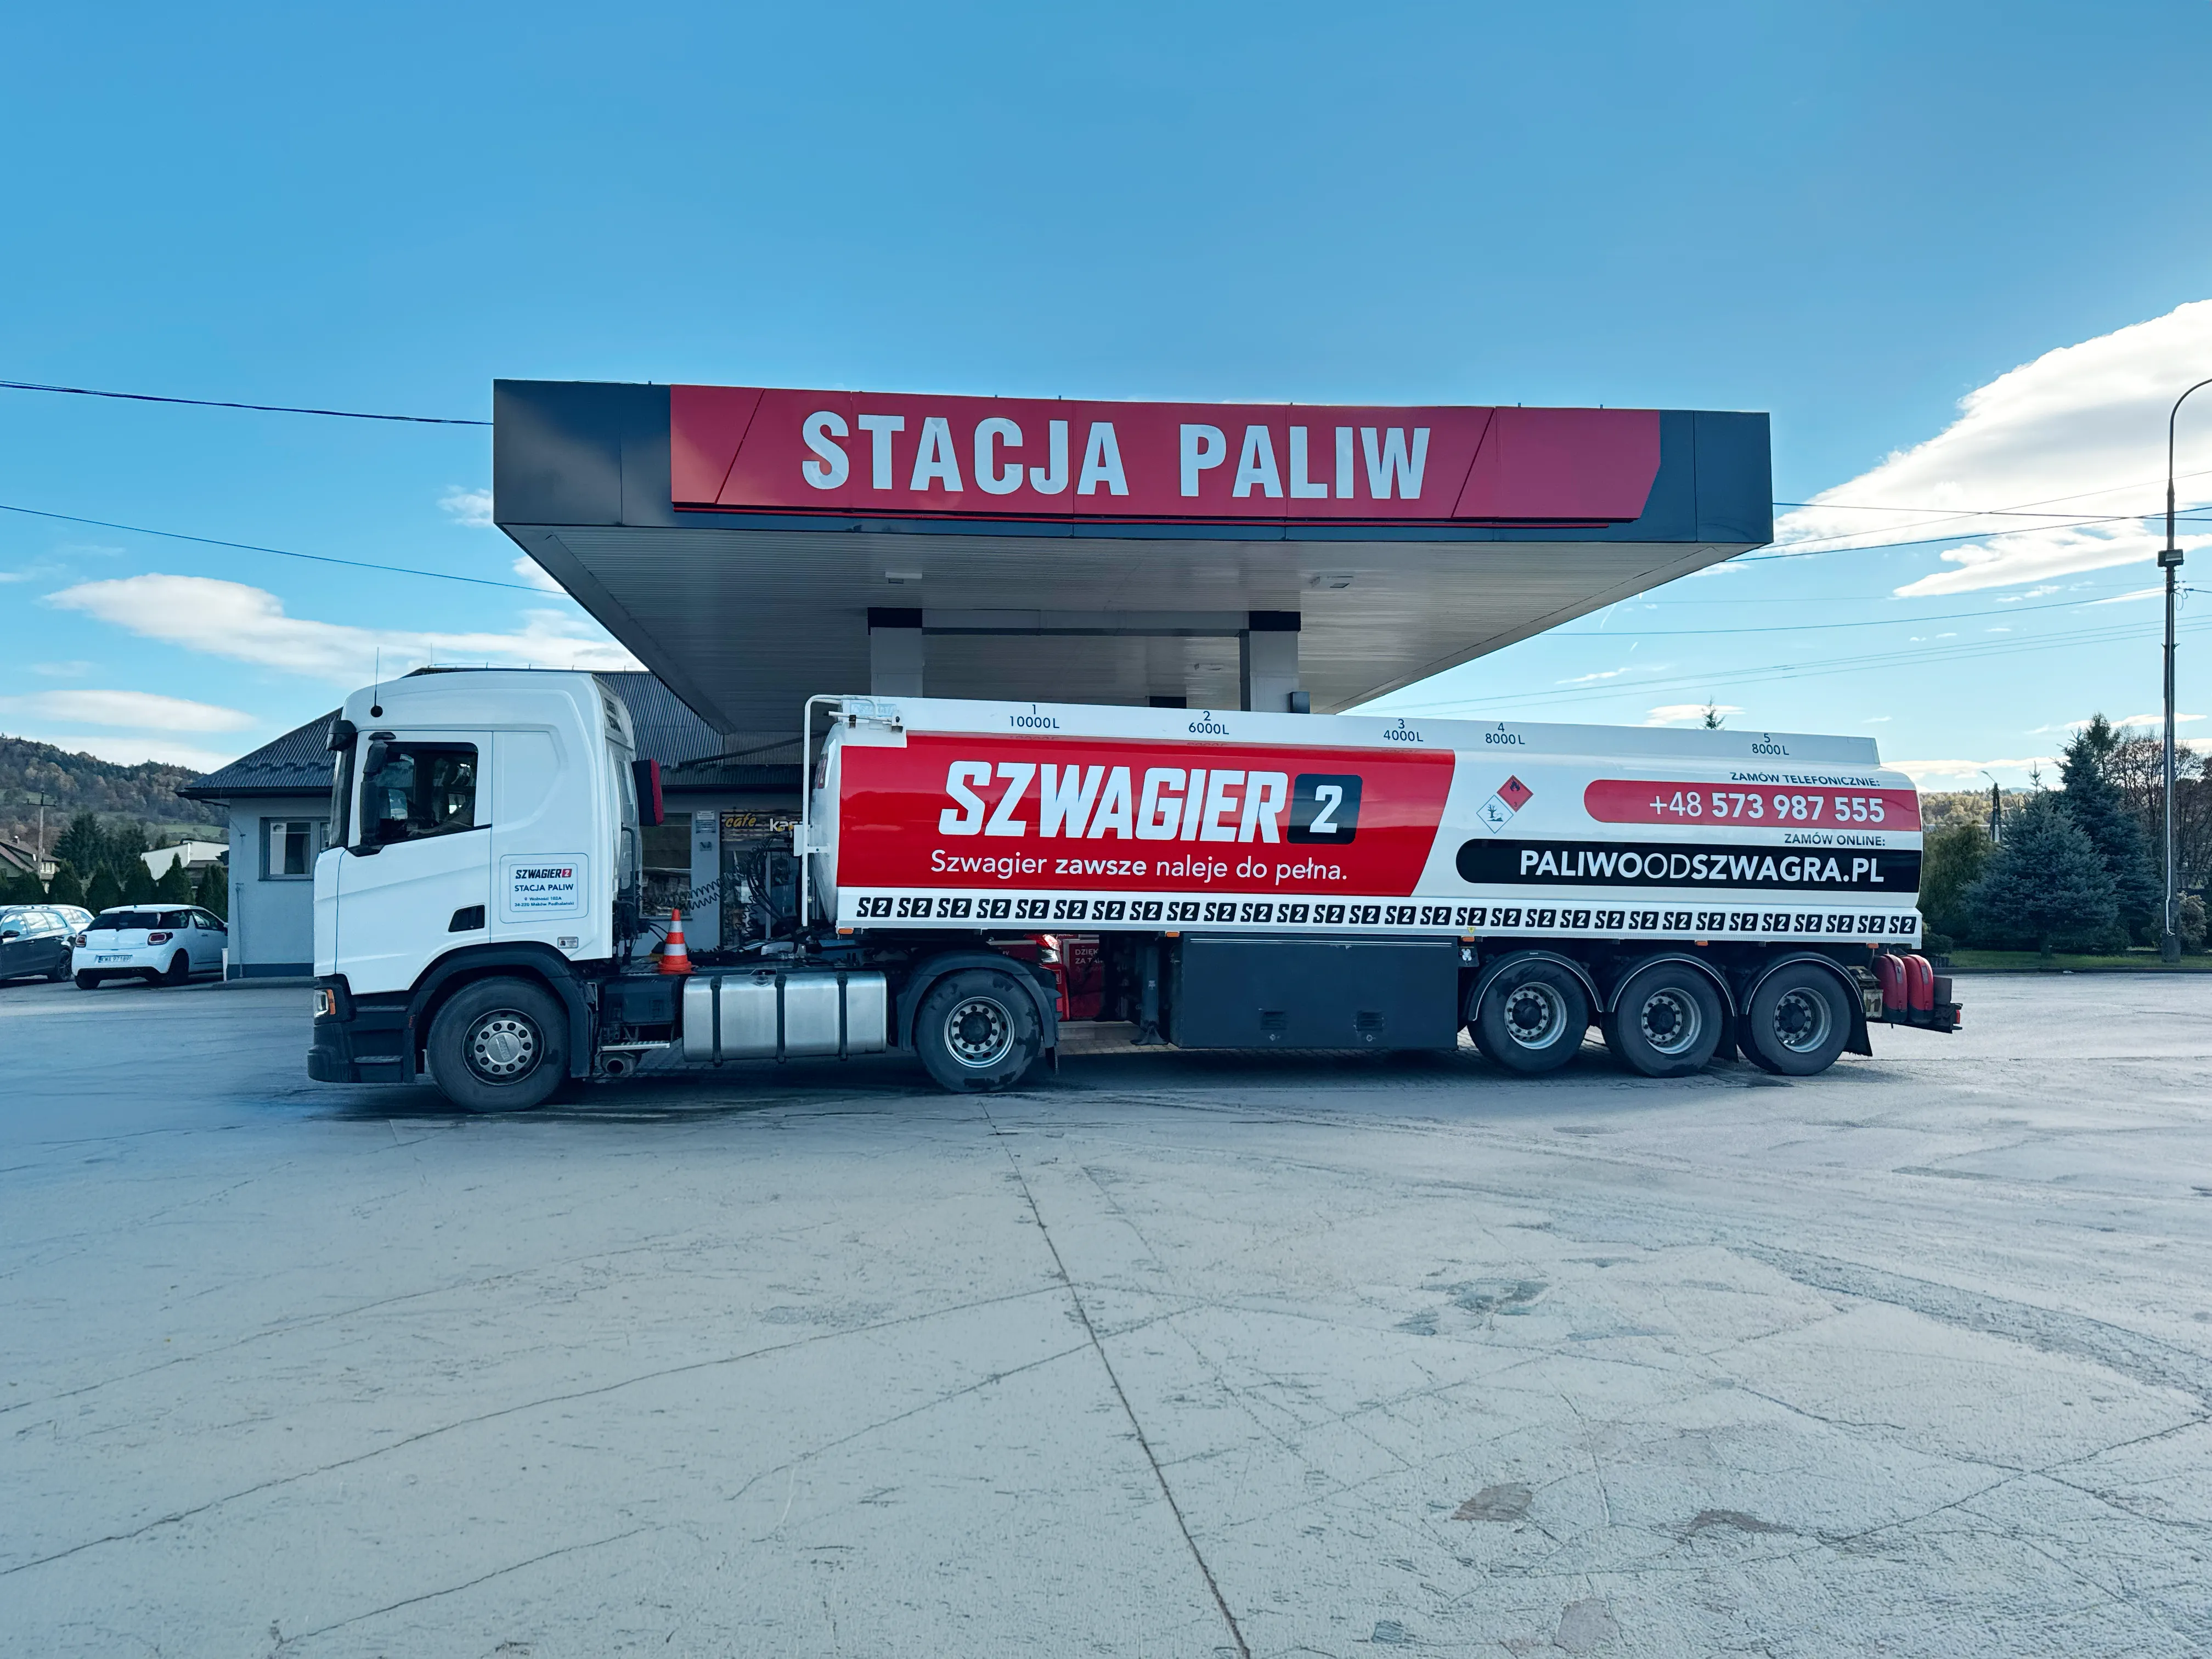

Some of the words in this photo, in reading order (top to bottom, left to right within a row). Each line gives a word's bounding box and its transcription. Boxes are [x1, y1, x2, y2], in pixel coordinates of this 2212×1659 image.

[802, 411, 1130, 496] STACJA
[1180, 424, 1431, 500] PALIW
[1032, 704, 1036, 715] 1
[1203, 710, 1211, 721] 2
[1009, 716, 1060, 729] 10000L
[1398, 718, 1405, 729] 3
[1497, 722, 1505, 732] 4
[1188, 723, 1229, 735] 6000L
[1383, 730, 1424, 742] 4000L
[1763, 733, 1771, 743] 5
[1730, 769, 1779, 783] ZAMÓW
[1782, 775, 1881, 787] TELEFONICZNIE:
[938, 760, 1289, 844] SZWAGIER
[1309, 785, 1343, 833] 2
[1650, 792, 1702, 817] +48
[1712, 792, 1764, 819] 573
[1773, 794, 1824, 820] 987
[1835, 797, 1885, 823] 555
[725, 813, 757, 828] cafe
[1784, 832, 1833, 845] ZAMÓW
[1836, 835, 1886, 847] ONLINE:
[930, 849, 1047, 879] Szwagier
[1055, 859, 1147, 876] zawsze
[1156, 856, 1228, 883] naleje
[1236, 855, 1267, 878] do
[1275, 857, 1347, 886] pełna.
[1520, 850, 1884, 883] PALIWOODSZWAGRA.PL
[516, 868, 562, 879] SZWAGIER
[1075, 948, 1099, 956] DZIĘK
